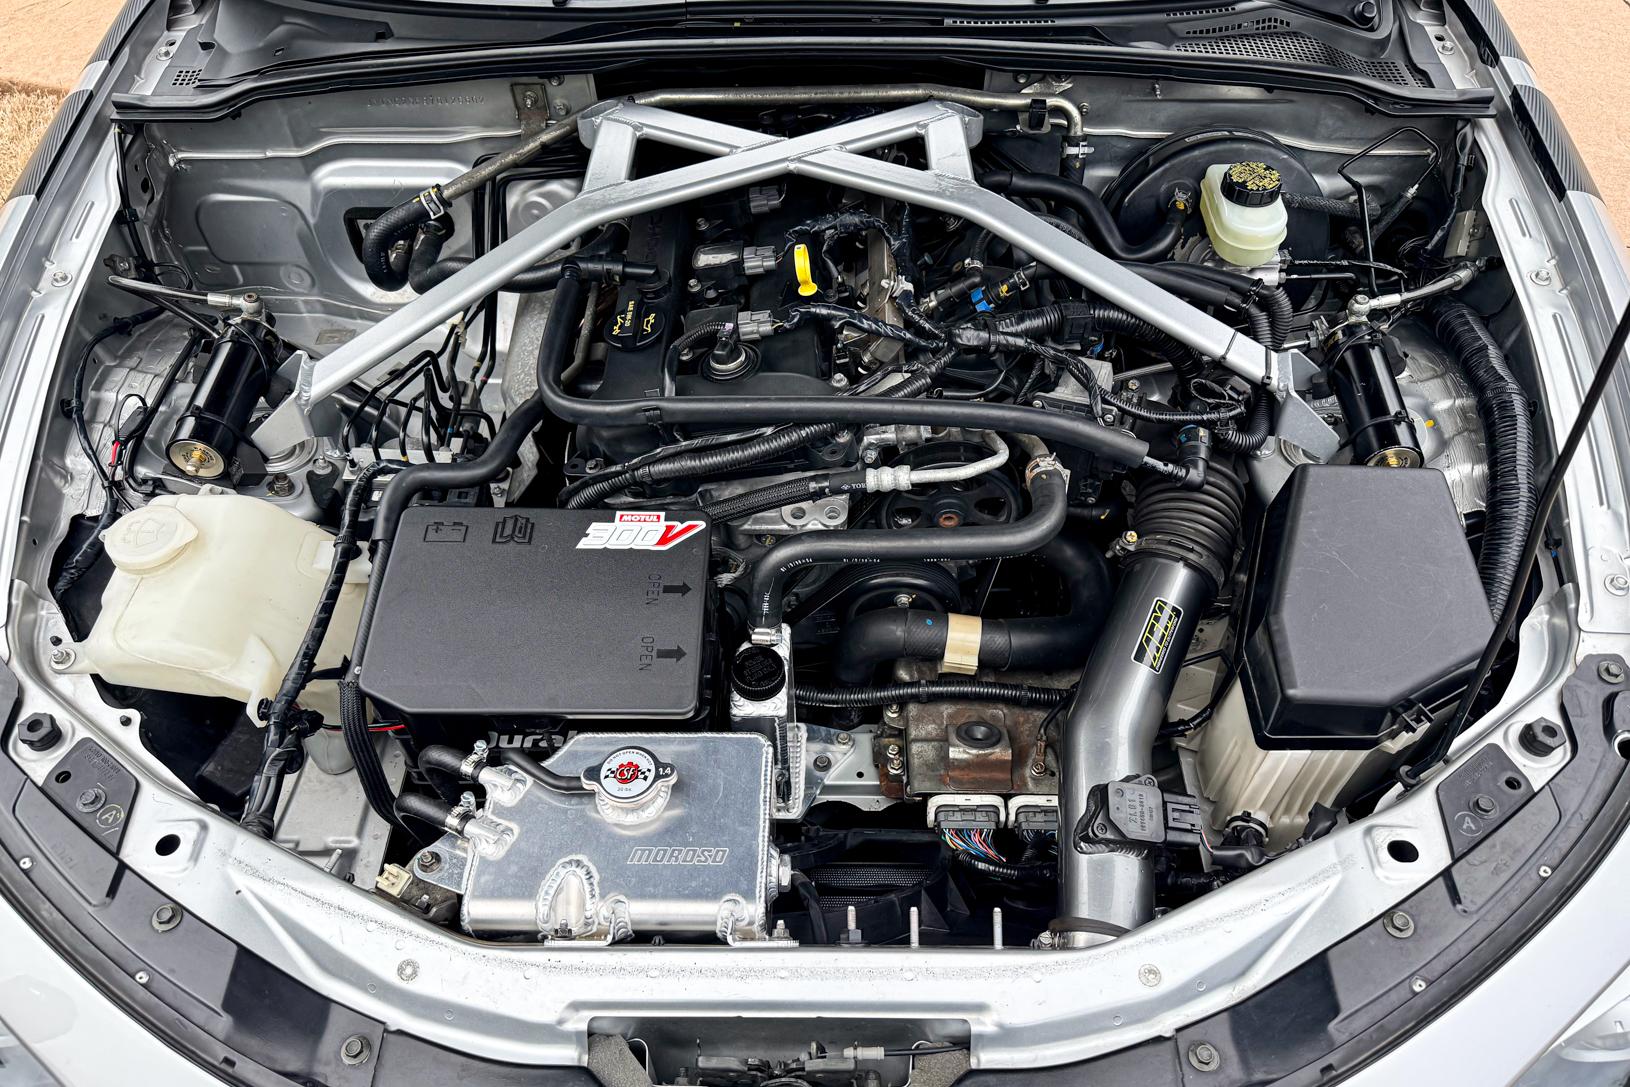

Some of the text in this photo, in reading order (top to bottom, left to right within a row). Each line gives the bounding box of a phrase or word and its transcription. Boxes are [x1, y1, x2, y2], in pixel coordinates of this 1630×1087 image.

[620, 514, 659, 522] MOTUL
[579, 522, 703, 549] 300V
[645, 573, 662, 606] OPEN
[1142, 600, 1176, 668] AEM
[638, 636, 655, 672] OPEN
[616, 767, 636, 779] CSF
[658, 767, 671, 776] 1.4
[101, 809, 117, 823] A
[1462, 816, 1476, 830] A
[626, 846, 729, 865] MOROSO
